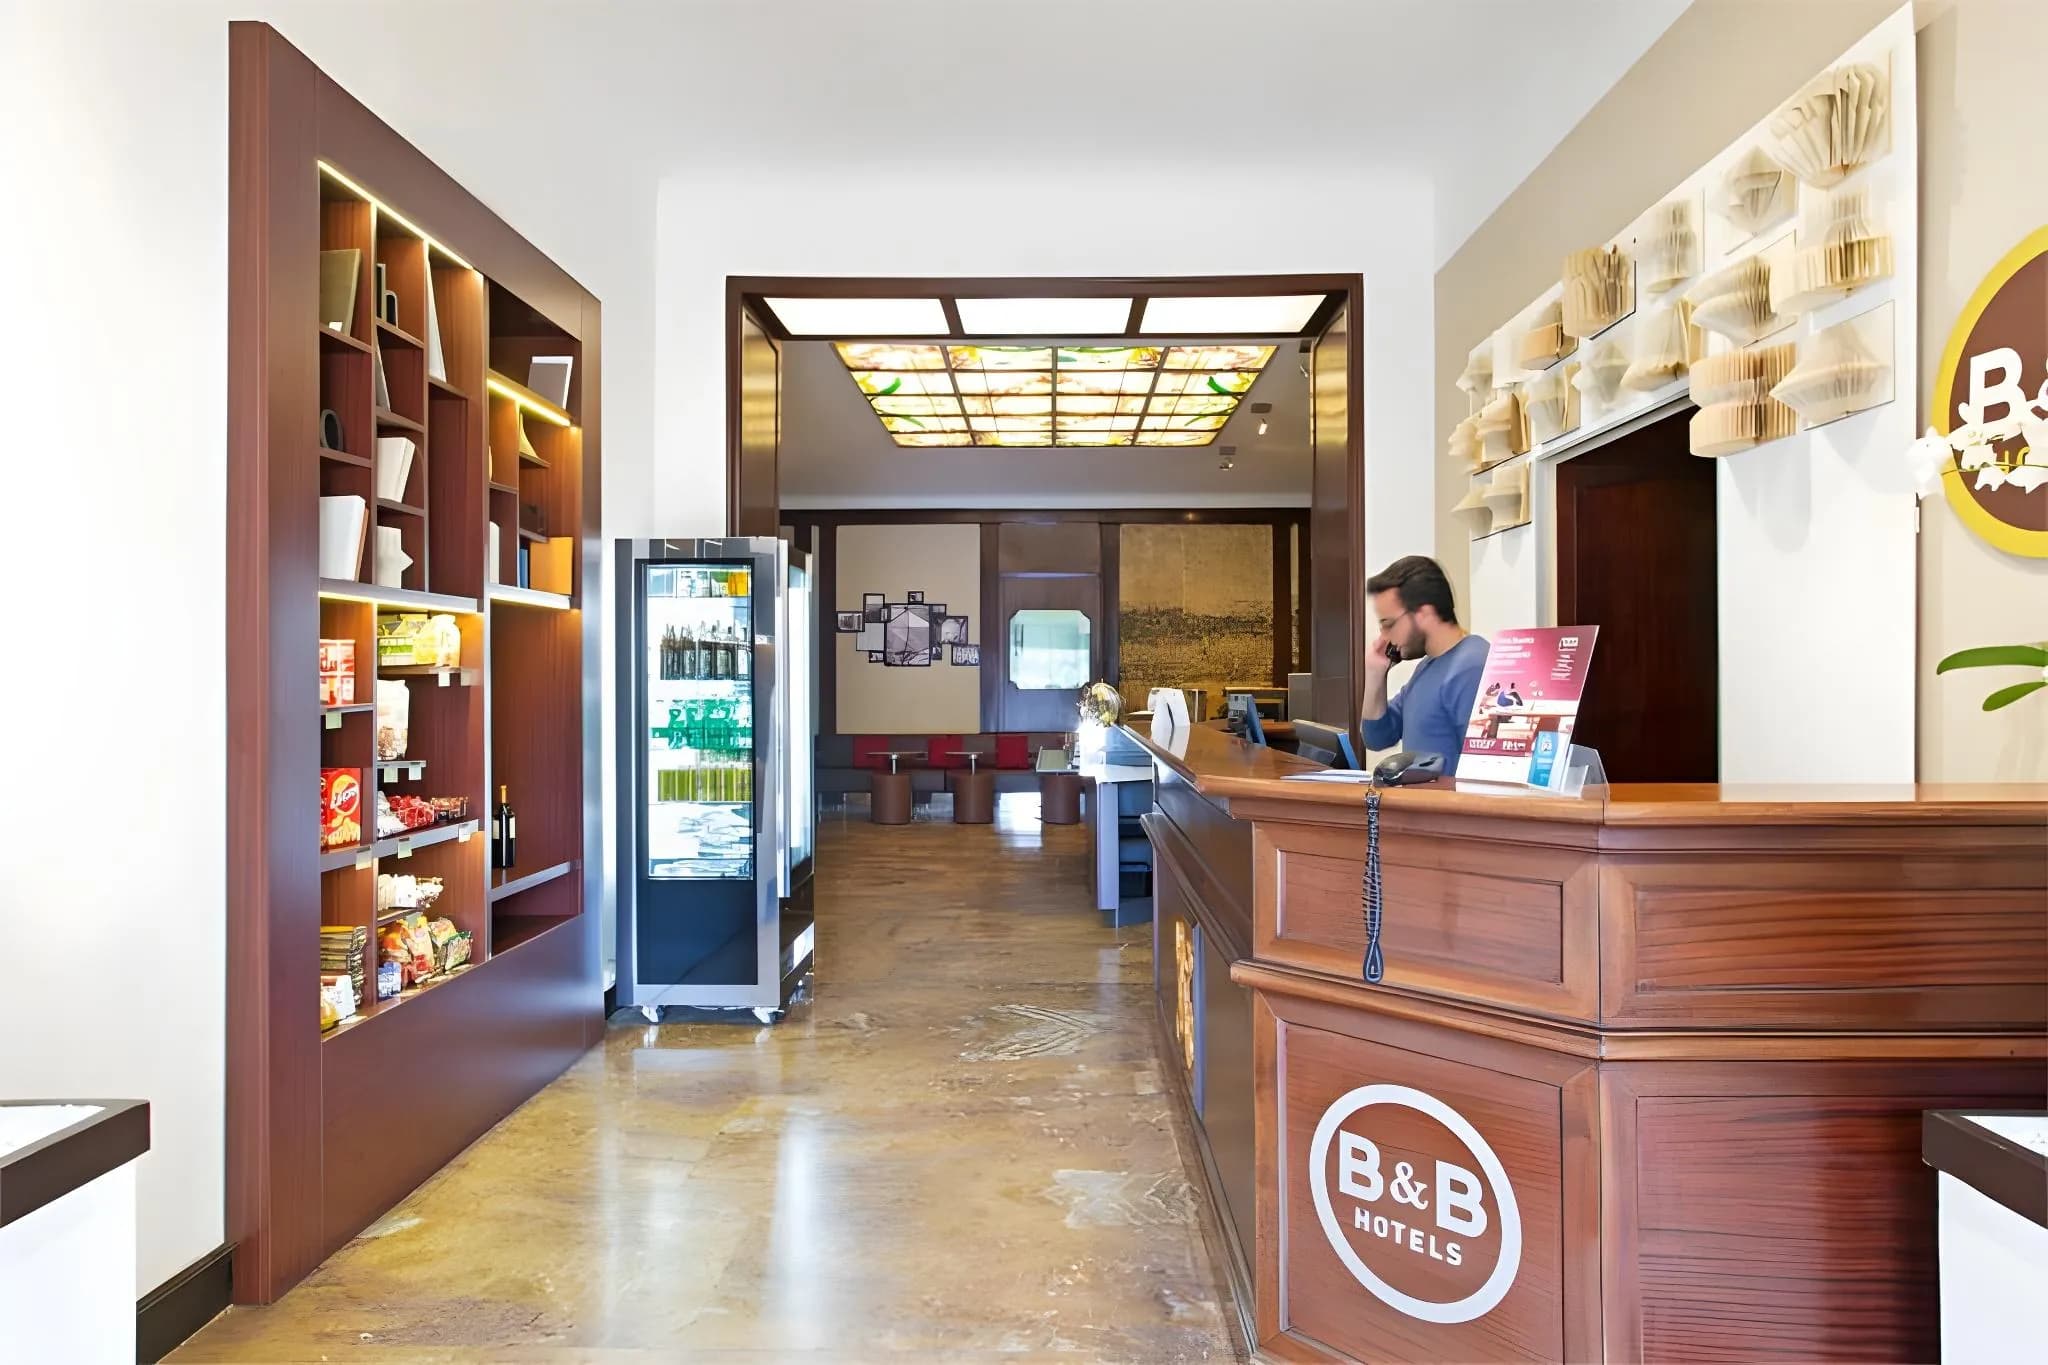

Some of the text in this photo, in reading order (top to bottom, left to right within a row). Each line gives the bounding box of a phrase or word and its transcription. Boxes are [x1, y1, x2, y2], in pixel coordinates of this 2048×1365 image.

[1968, 347, 2048, 428] B
[1339, 1129, 1488, 1238] B&B
[1354, 1206, 1462, 1266] HOTELS
